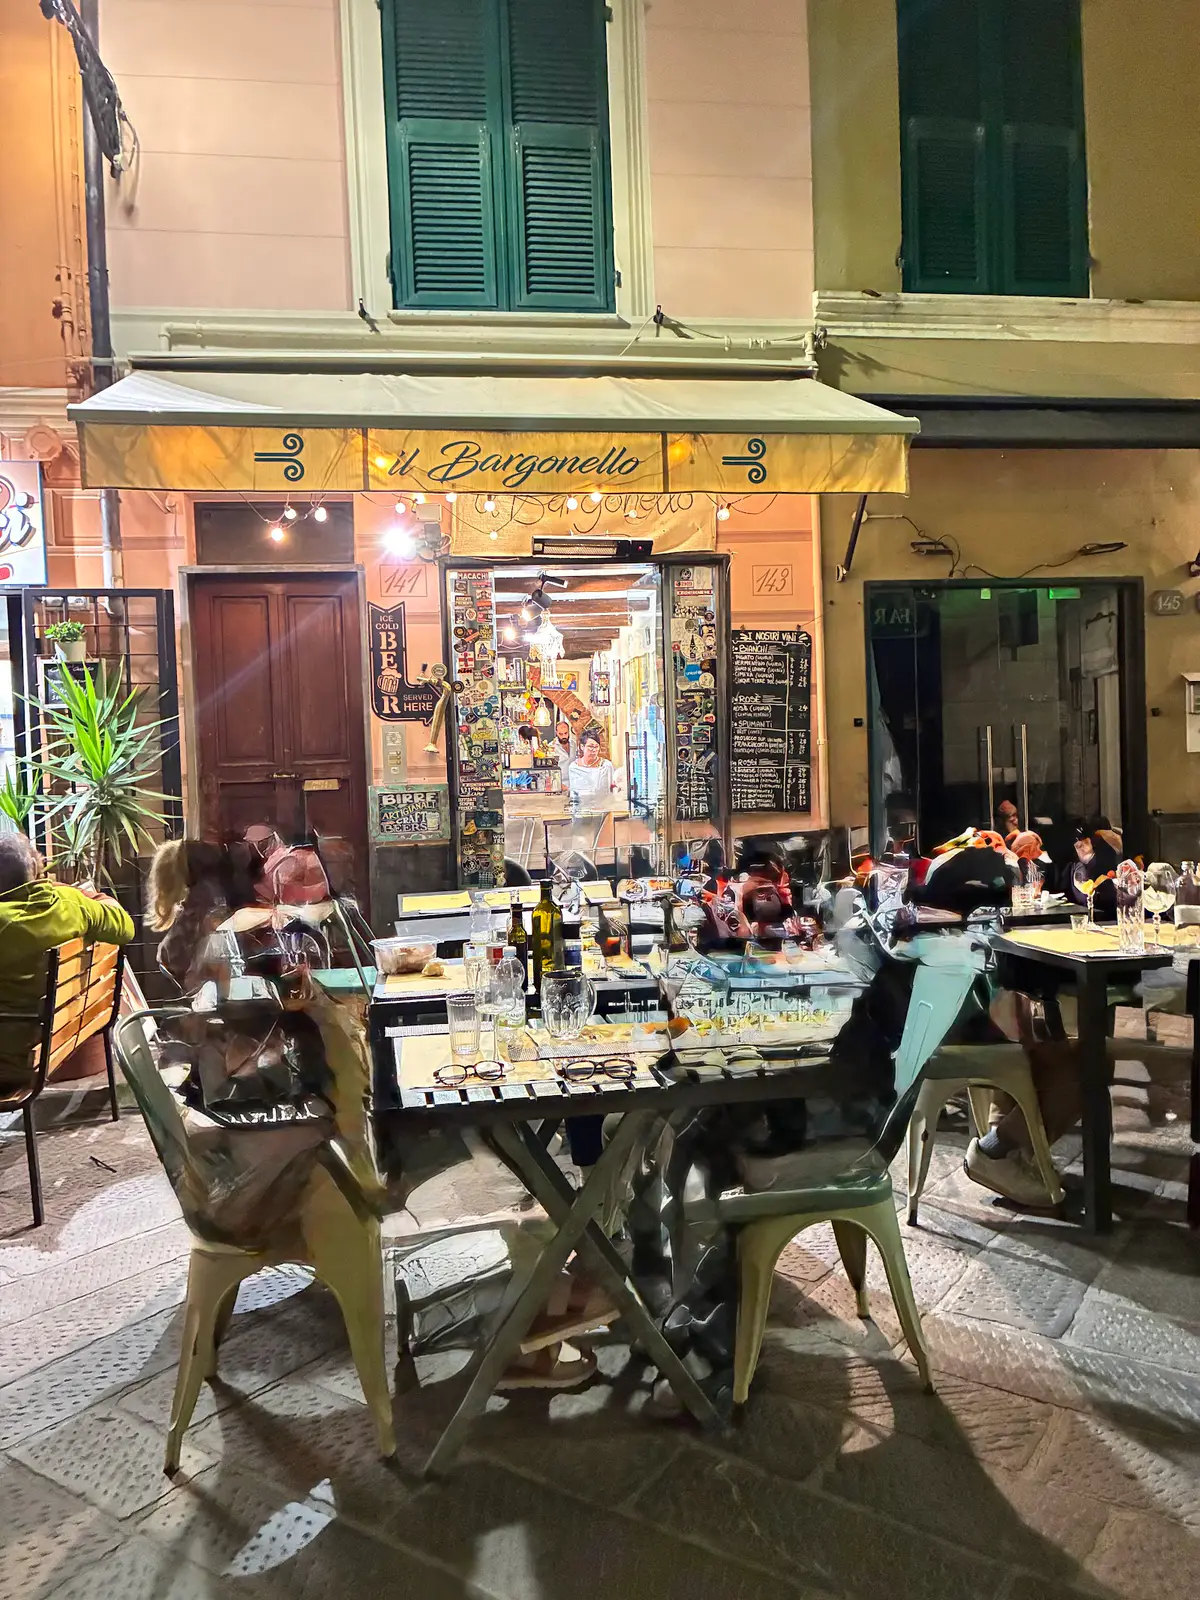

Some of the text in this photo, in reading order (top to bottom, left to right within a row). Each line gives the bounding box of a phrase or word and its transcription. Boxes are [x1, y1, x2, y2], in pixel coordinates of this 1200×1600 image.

[388, 440, 642, 488] il Bargonello
[384, 568, 422, 593] 141
[756, 568, 790, 592] 143
[1157, 595, 1181, 610] 145
[403, 702, 433, 712] HERE
[382, 792, 436, 806] BIRRE
[382, 801, 435, 820] ARTIGIANALI
[396, 811, 427, 824] CRAFT
[383, 822, 428, 833] BEERS
